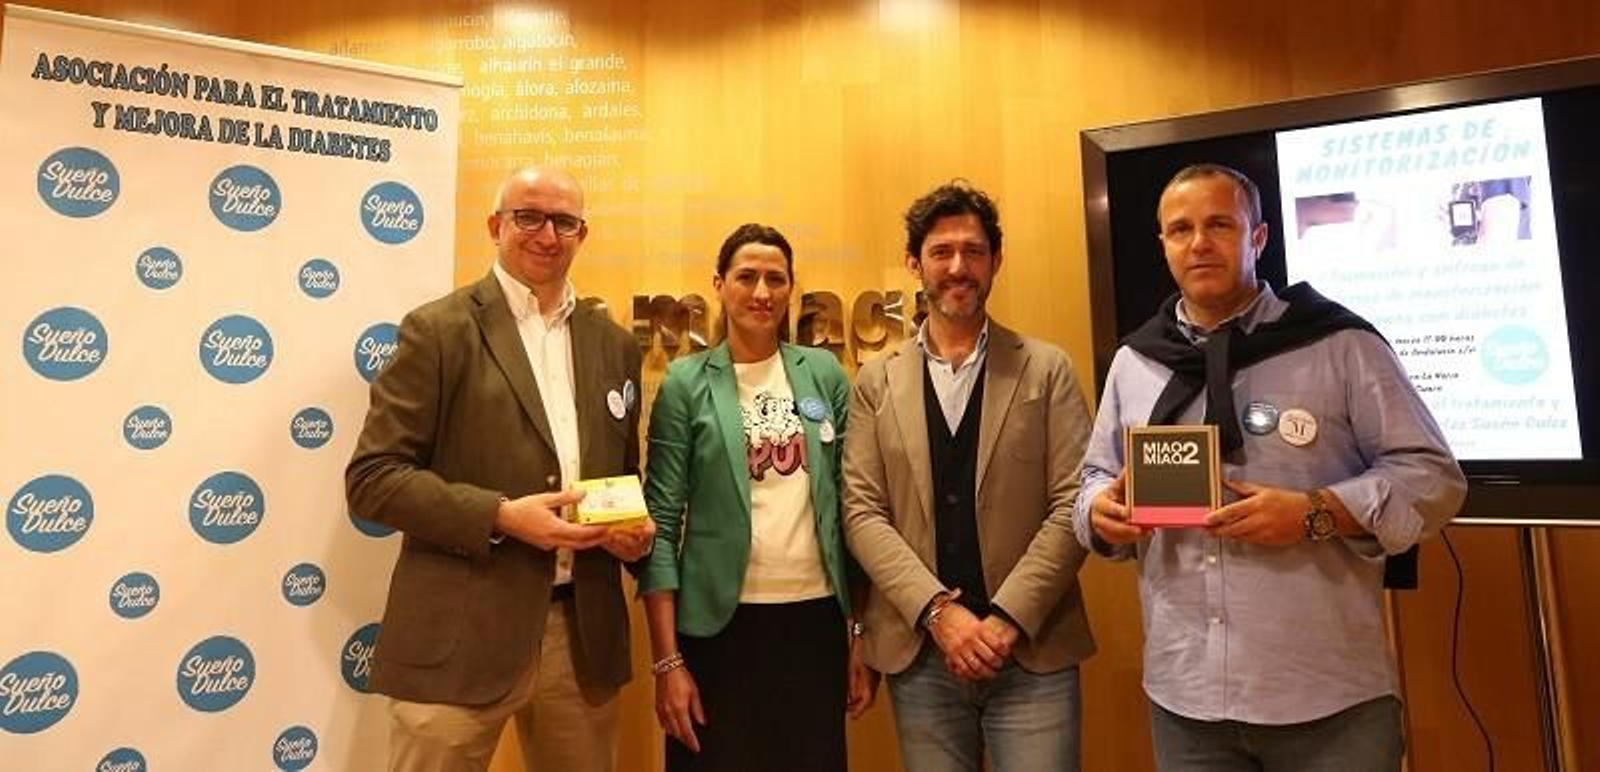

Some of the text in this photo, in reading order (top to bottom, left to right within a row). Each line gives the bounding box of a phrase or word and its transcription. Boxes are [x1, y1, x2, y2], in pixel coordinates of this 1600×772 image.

[31, 52, 439, 133] ASOCIACIÓN PARA EL TRATAMIENTO
[91, 101, 391, 163] Y MEJORA DE LA DIABETES
[1321, 118, 1497, 158] SISTEMAS DE
[42, 160, 108, 186] Sueño
[51, 181, 112, 203] Dulce
[213, 178, 271, 201] Sueño
[222, 198, 275, 218] Dulce
[364, 194, 414, 214] Sueño
[371, 210, 419, 230] Dulce
[28, 323, 96, 345] Sueño
[204, 329, 262, 352] Sueño
[37, 342, 100, 363] Dulce
[212, 350, 267, 368] Dulce
[12, 493, 82, 516] Sueño
[193, 488, 254, 510] Sueño
[21, 513, 86, 534] Dulce
[202, 506, 258, 526] Dulce
[181, 655, 244, 677] Sueño
[0, 672, 66, 696] Sueño
[191, 673, 248, 695] Dulce
[3, 691, 71, 716] Dulce
